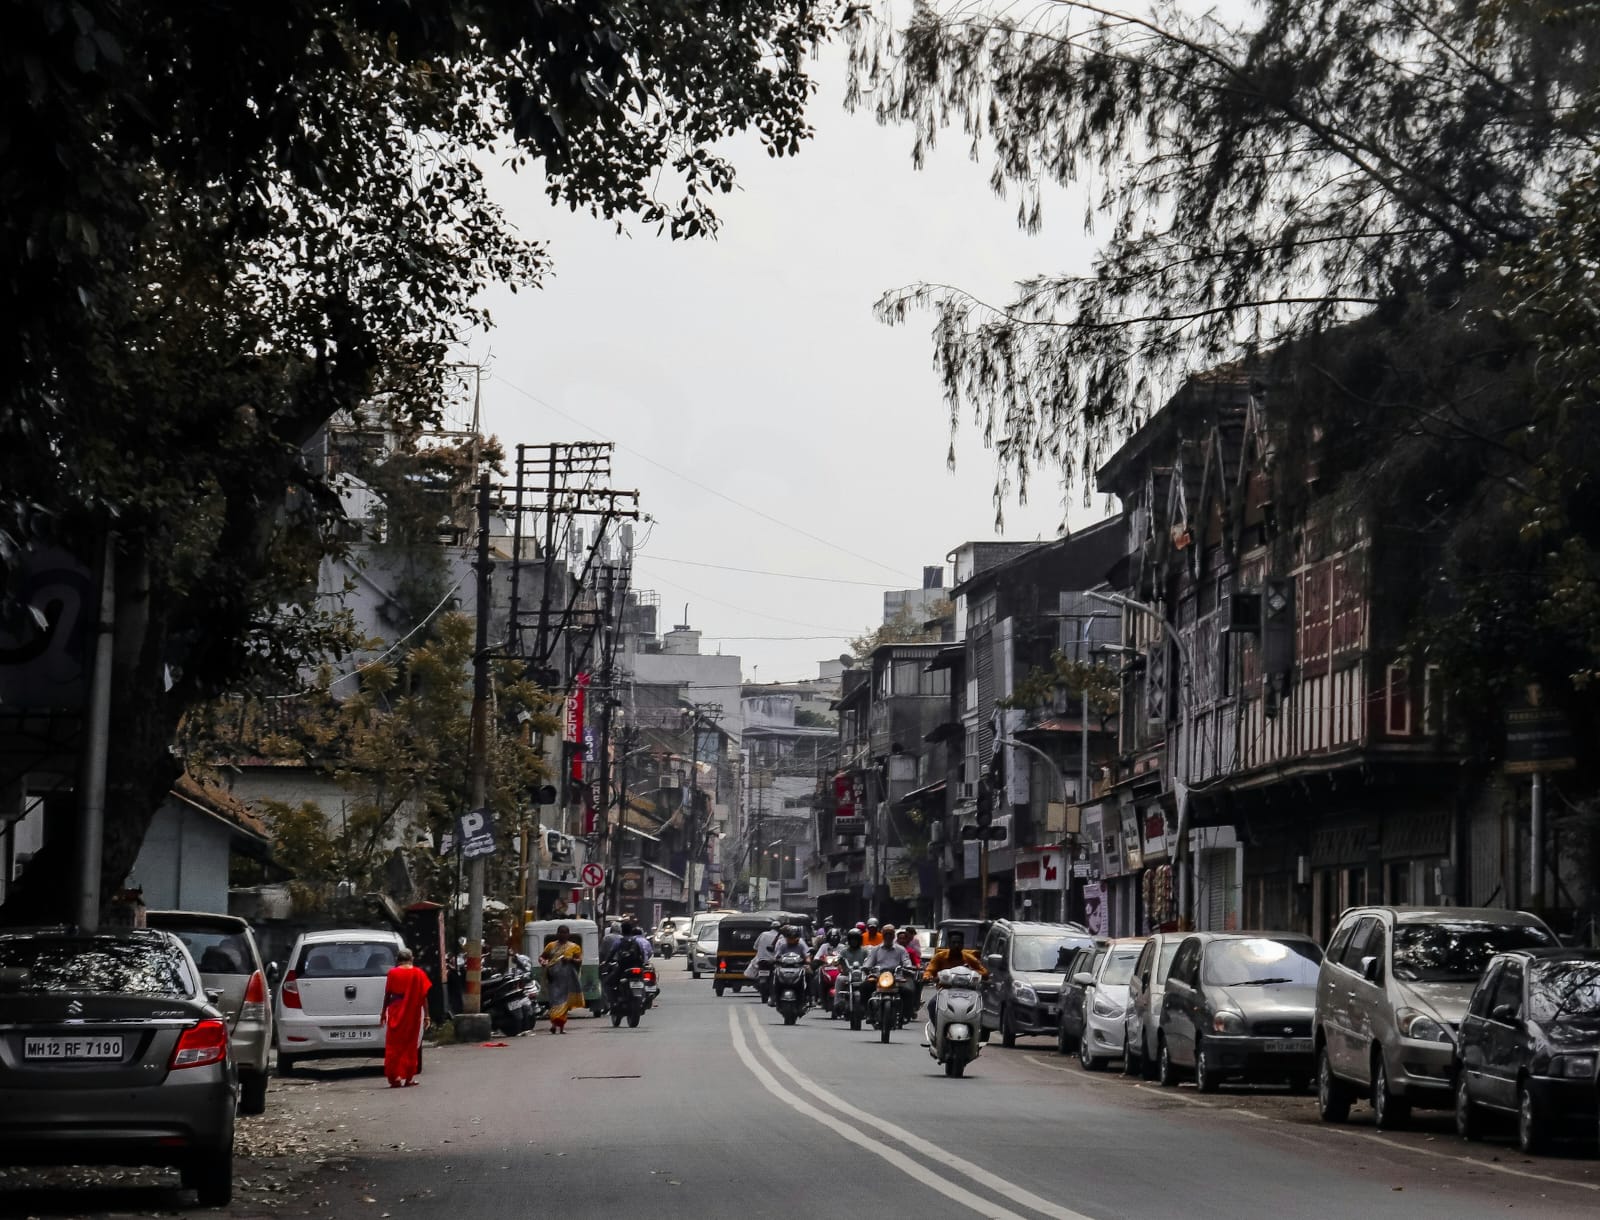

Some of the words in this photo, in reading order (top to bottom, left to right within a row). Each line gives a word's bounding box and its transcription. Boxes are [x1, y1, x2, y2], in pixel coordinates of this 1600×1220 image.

[461, 812, 484, 838] P
[64, 1042, 81, 1055] RF
[86, 1041, 120, 1055] 7190
